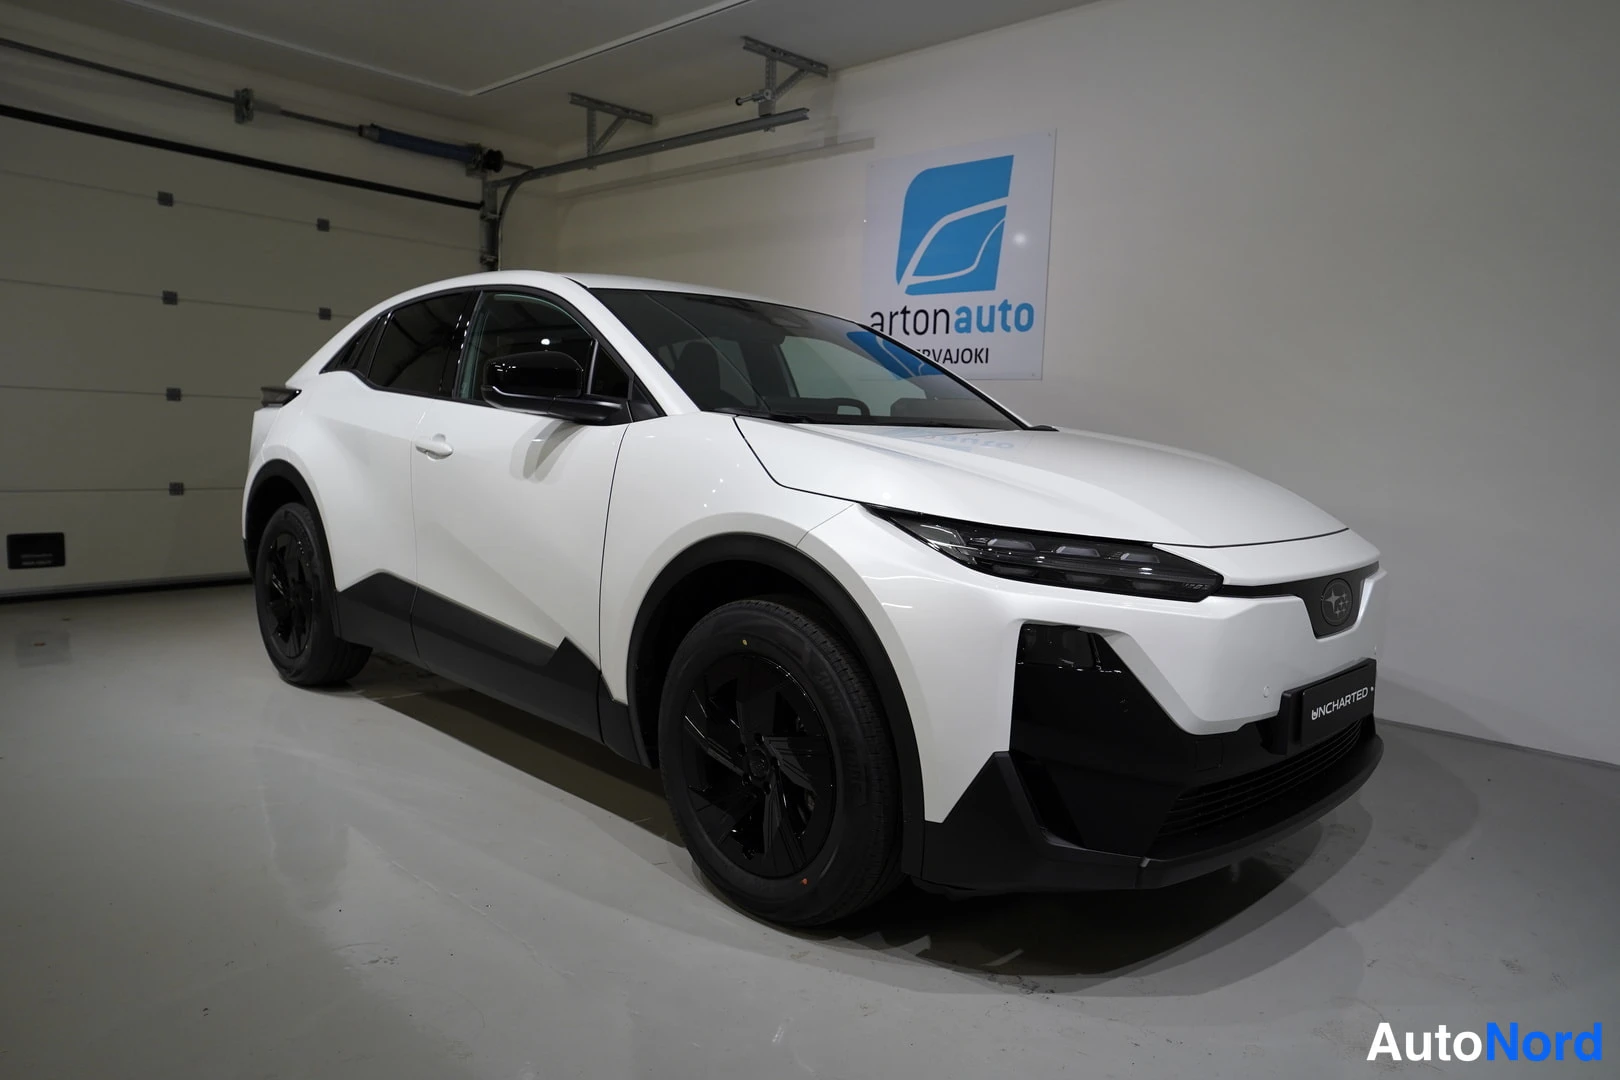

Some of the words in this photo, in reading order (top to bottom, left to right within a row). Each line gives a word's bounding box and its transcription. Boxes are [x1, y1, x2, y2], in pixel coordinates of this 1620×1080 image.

[870, 299, 1034, 336] artonauto
[916, 347, 989, 364] RVAJOKI
[1311, 687, 1368, 720] UNCHARTED
